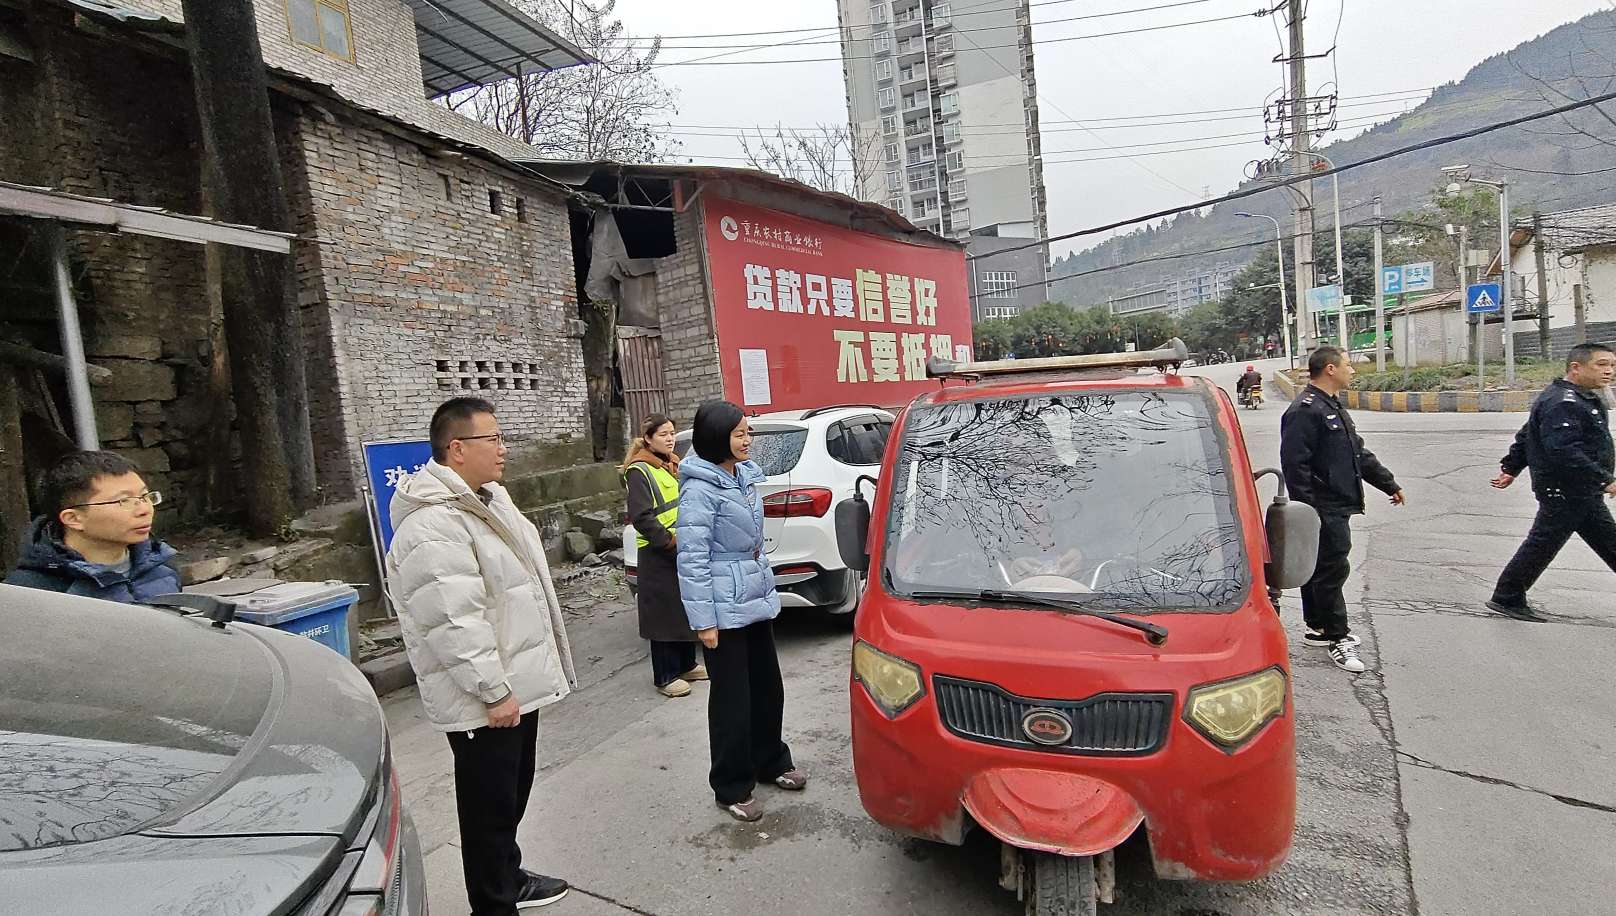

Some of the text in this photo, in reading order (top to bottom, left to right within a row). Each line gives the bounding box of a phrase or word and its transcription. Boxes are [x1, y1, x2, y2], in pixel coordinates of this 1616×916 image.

[741, 220, 823, 250] 重庆农村商业银行
[744, 263, 938, 326] 贷款只要信誉好
[1384, 270, 1400, 291] P
